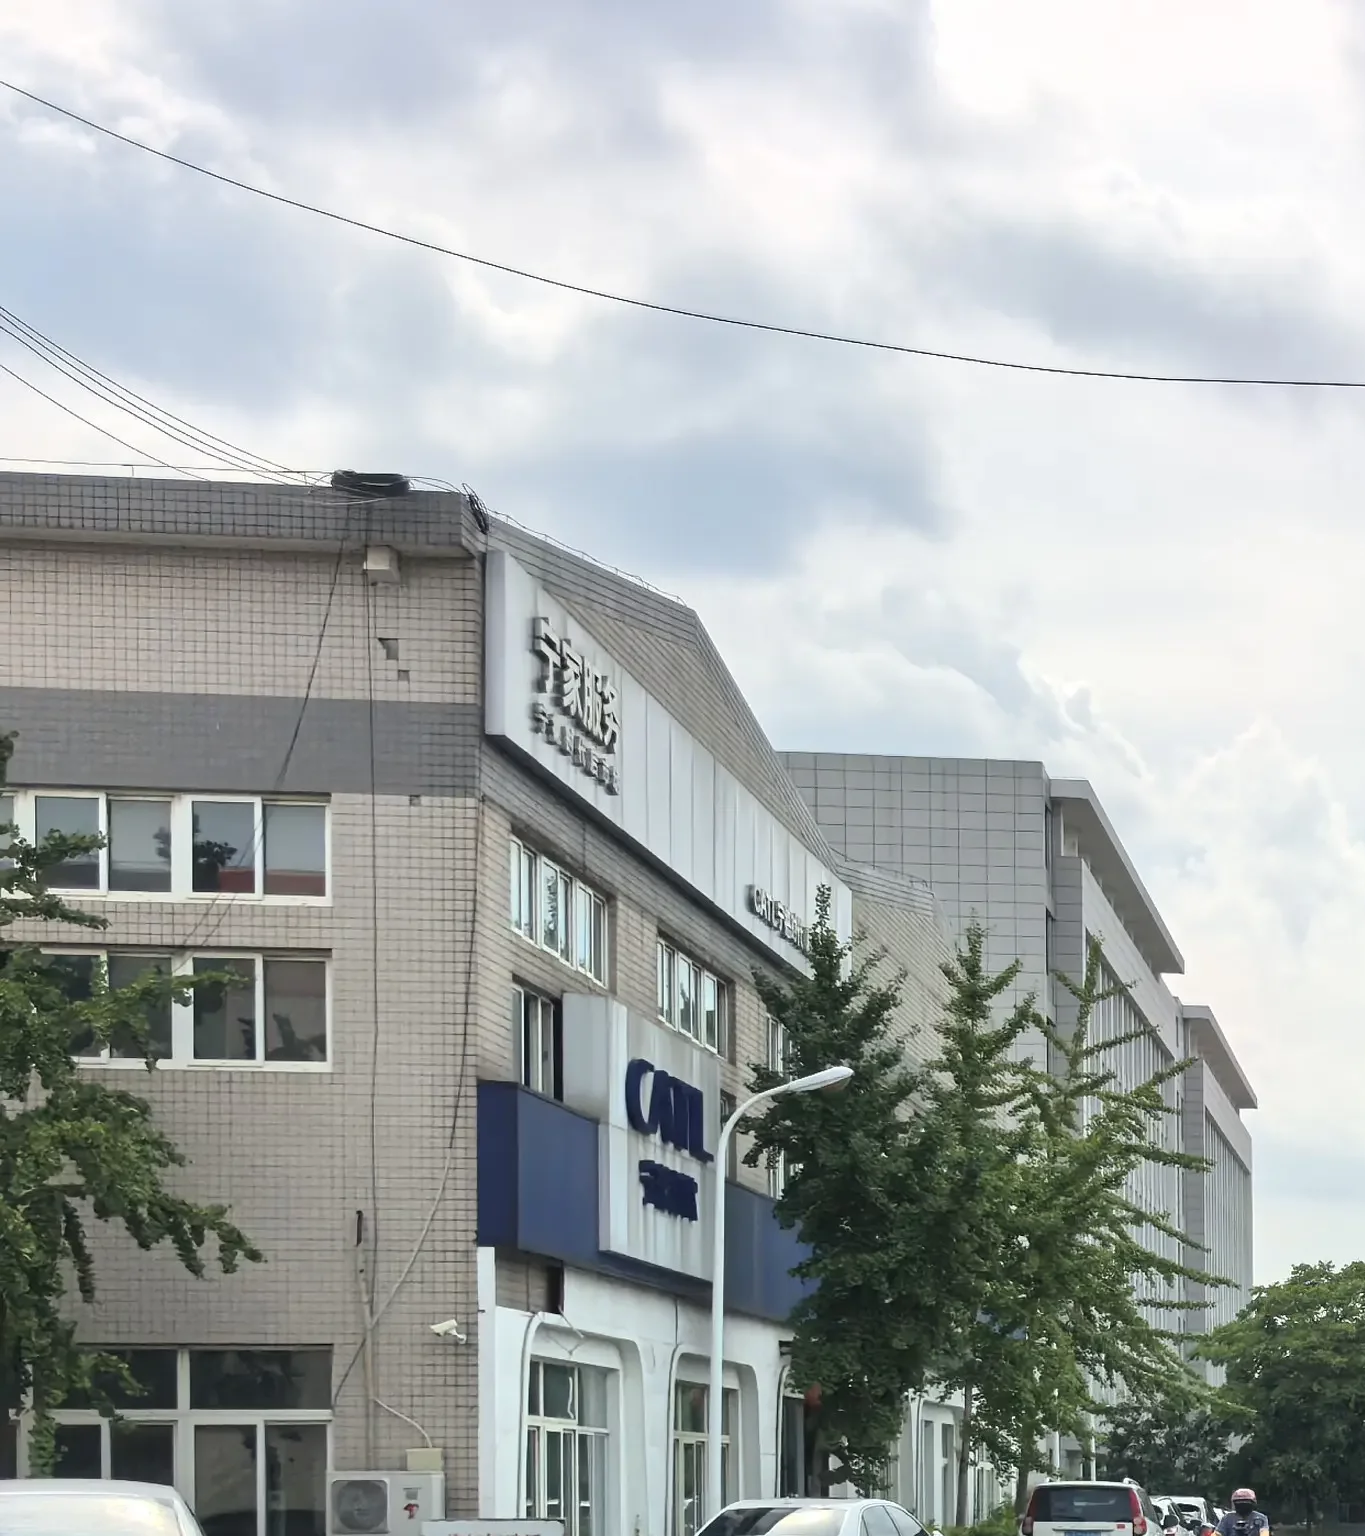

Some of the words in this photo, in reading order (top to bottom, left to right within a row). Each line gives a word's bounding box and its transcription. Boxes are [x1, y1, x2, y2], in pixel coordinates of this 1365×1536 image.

[534, 617, 620, 754] 宁家服务
[625, 1058, 714, 1164] CATL
